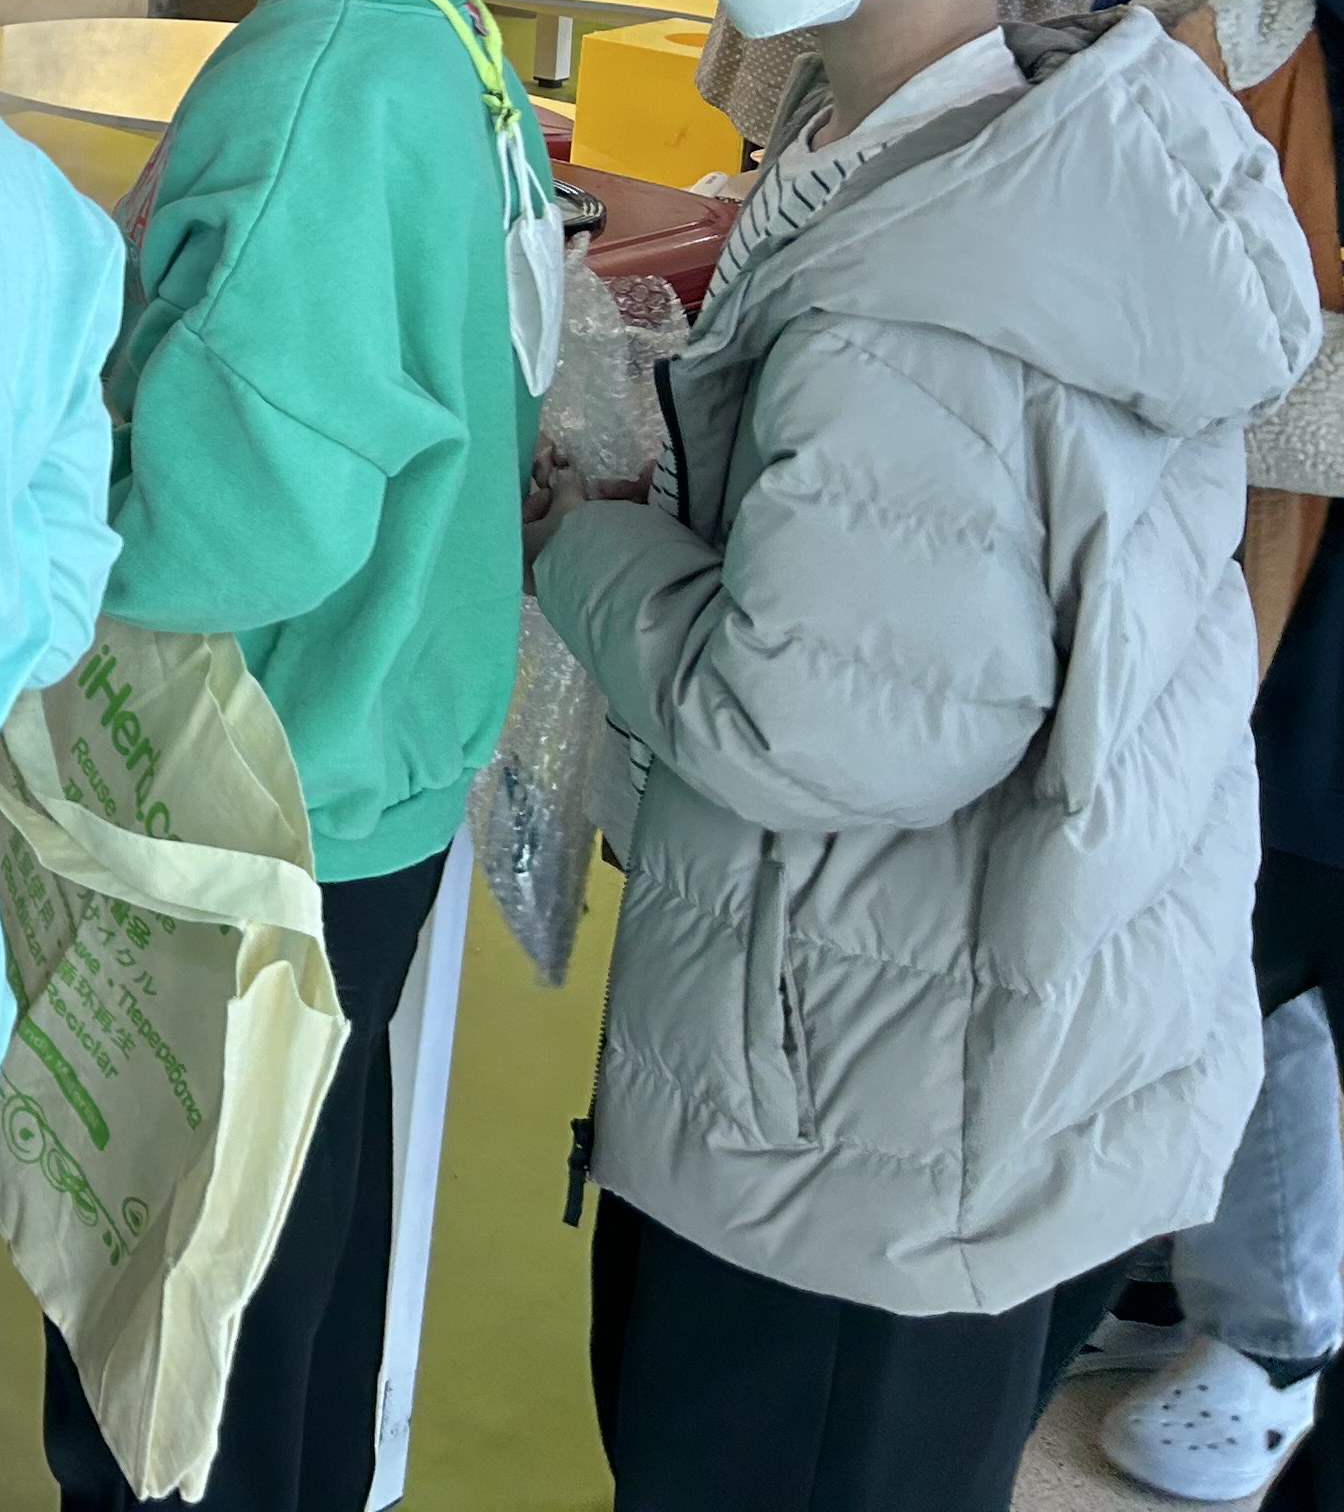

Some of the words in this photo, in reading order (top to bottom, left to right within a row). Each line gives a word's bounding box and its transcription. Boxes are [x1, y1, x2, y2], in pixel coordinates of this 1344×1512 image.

[71, 736, 117, 818] Reuse
[46, 981, 119, 1079] Reciclar
[117, 986, 203, 1132] Переработка
